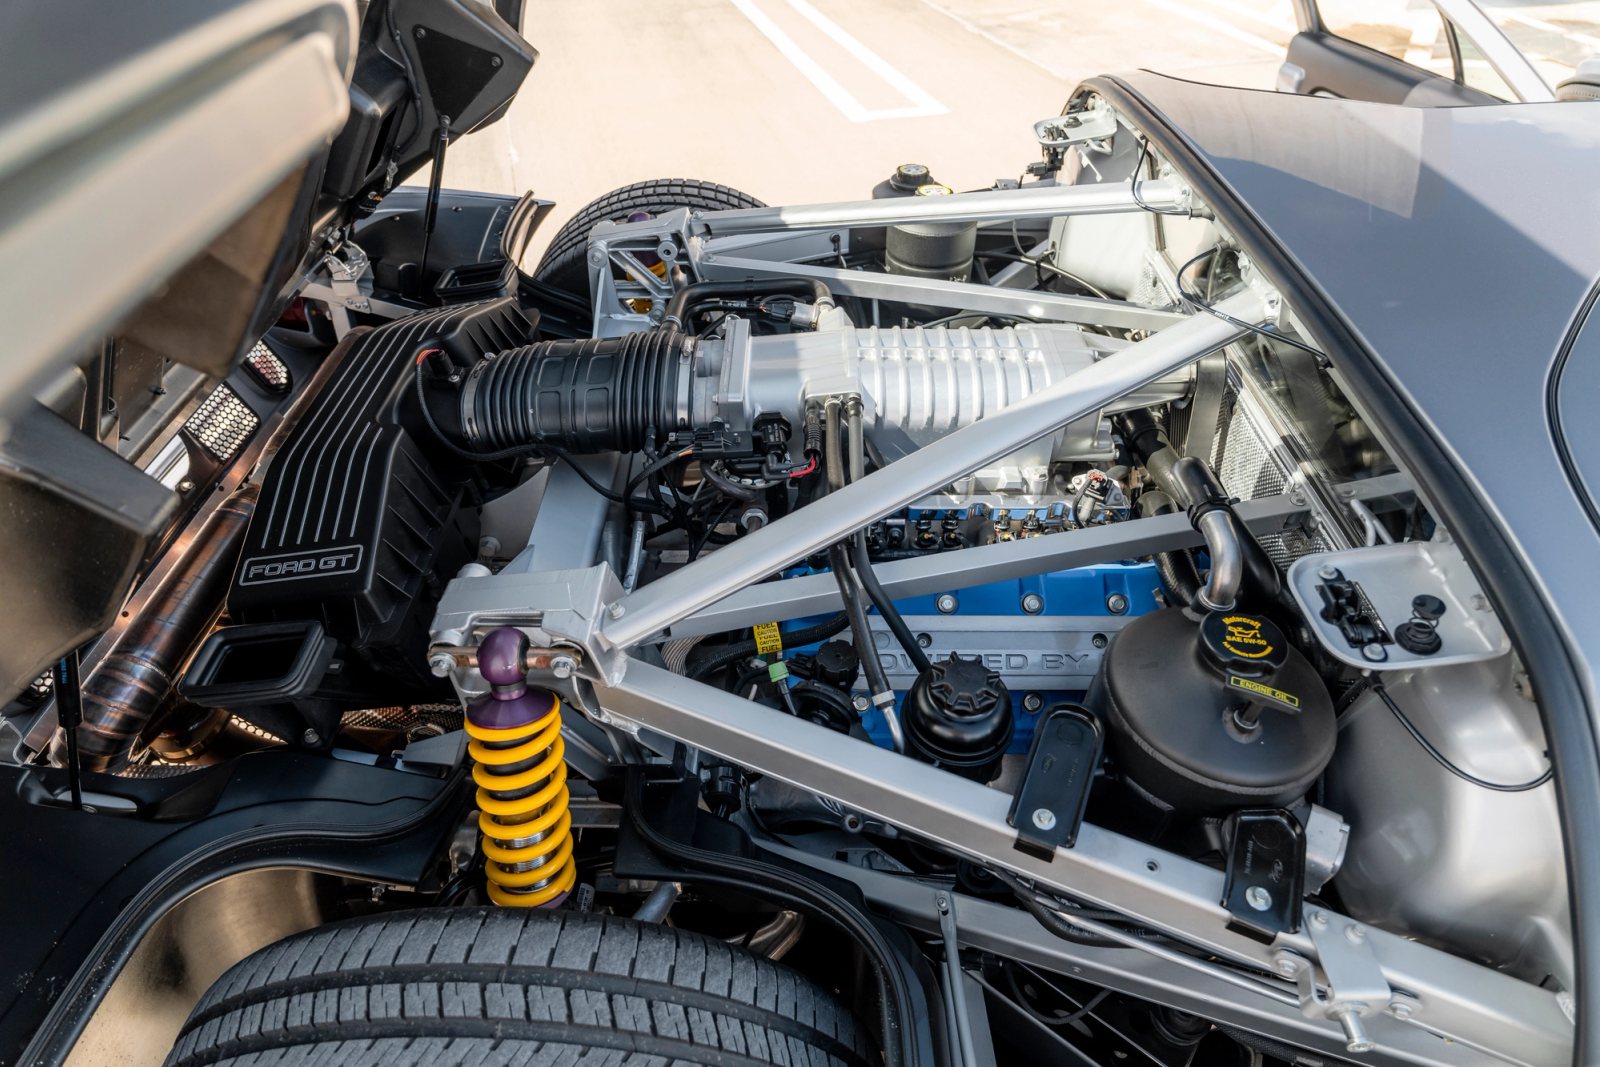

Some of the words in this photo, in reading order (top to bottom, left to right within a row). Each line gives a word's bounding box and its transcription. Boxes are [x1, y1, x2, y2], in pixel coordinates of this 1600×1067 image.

[248, 559, 316, 578] FORD
[318, 553, 354, 570] GT
[756, 622, 776, 630] FUEL
[1225, 635, 1243, 643] SAE
[761, 645, 780, 653] FUEL
[1041, 653, 1089, 670] BY
[1239, 679, 1273, 696] ENGINE
[1274, 689, 1289, 702] OIL
